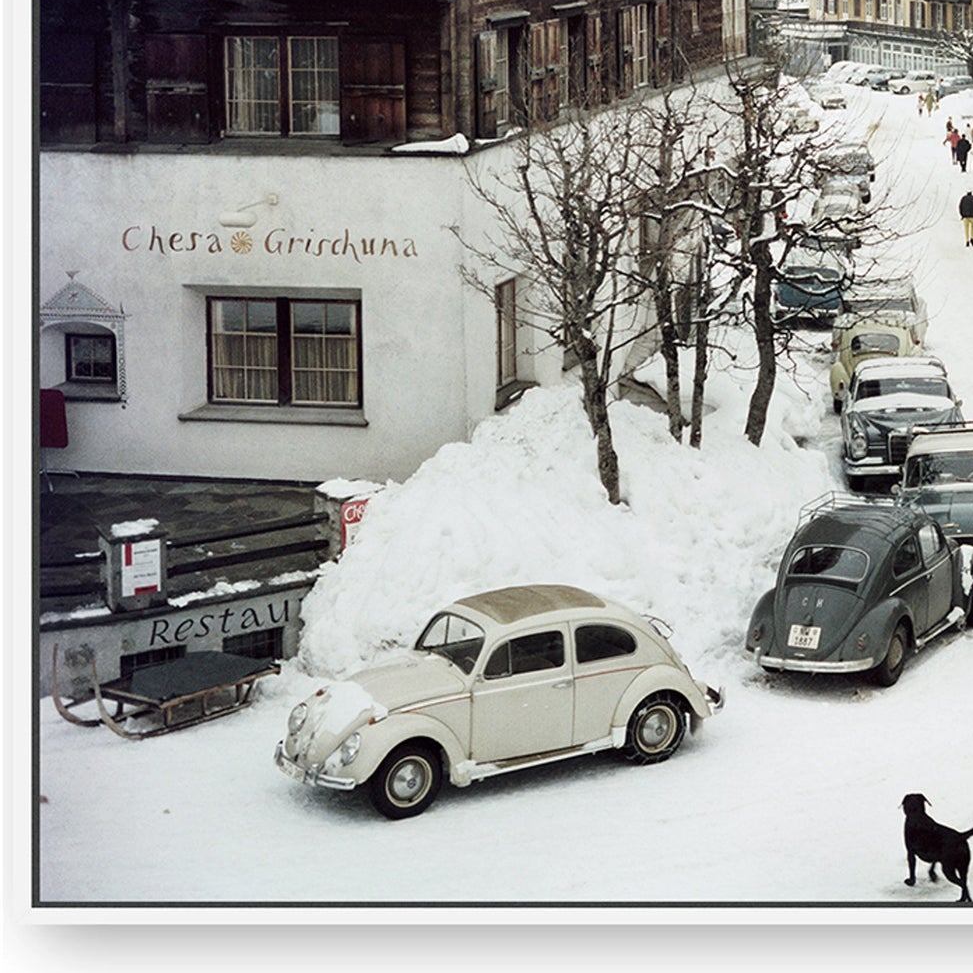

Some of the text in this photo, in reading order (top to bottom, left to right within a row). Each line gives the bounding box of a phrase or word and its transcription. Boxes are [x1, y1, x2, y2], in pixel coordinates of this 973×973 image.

[122, 226, 418, 264] Chesa Grischuna
[149, 599, 290, 647] Restau
